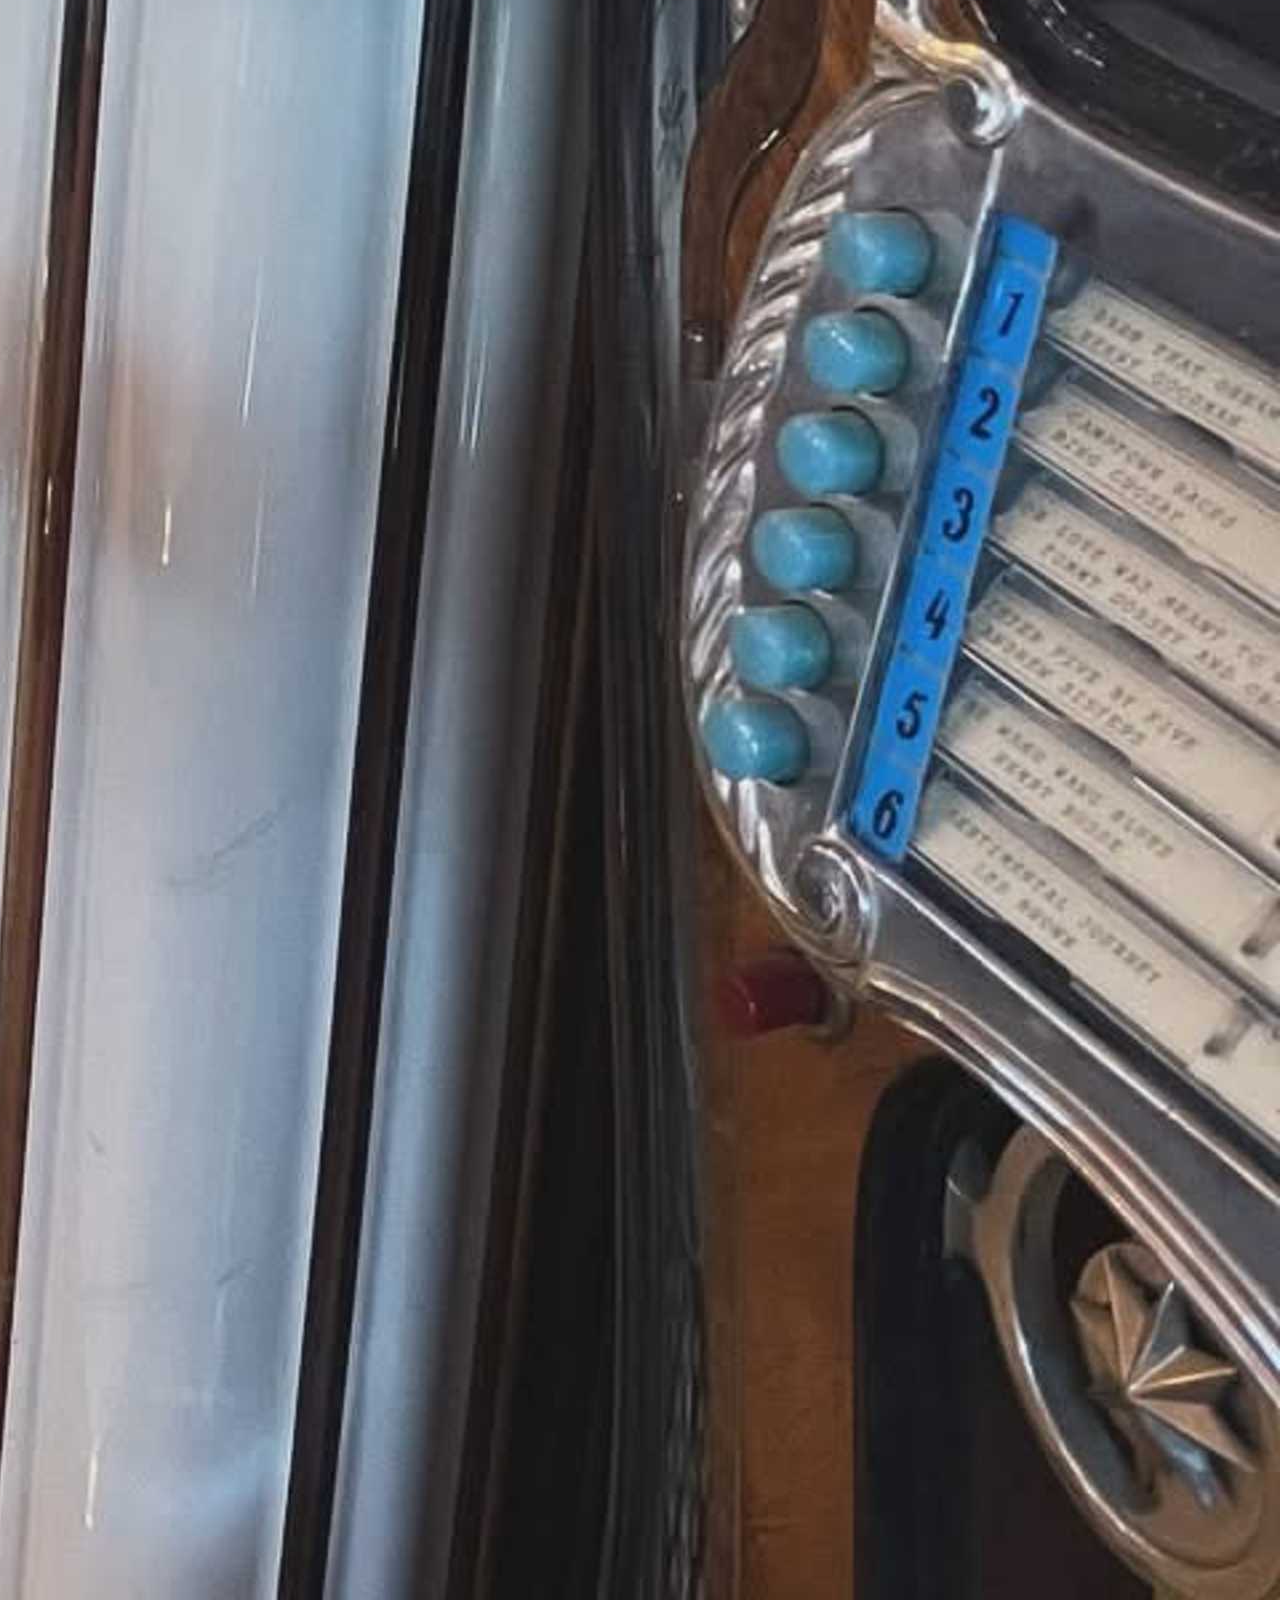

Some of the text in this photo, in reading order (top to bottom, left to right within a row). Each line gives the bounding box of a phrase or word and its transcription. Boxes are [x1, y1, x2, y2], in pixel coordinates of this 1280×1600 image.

[998, 293, 1024, 336] 1
[970, 388, 1000, 439] 2
[942, 488, 975, 541] 3
[922, 590, 948, 641] 4
[896, 693, 928, 740] 5
[873, 791, 904, 837] 6
